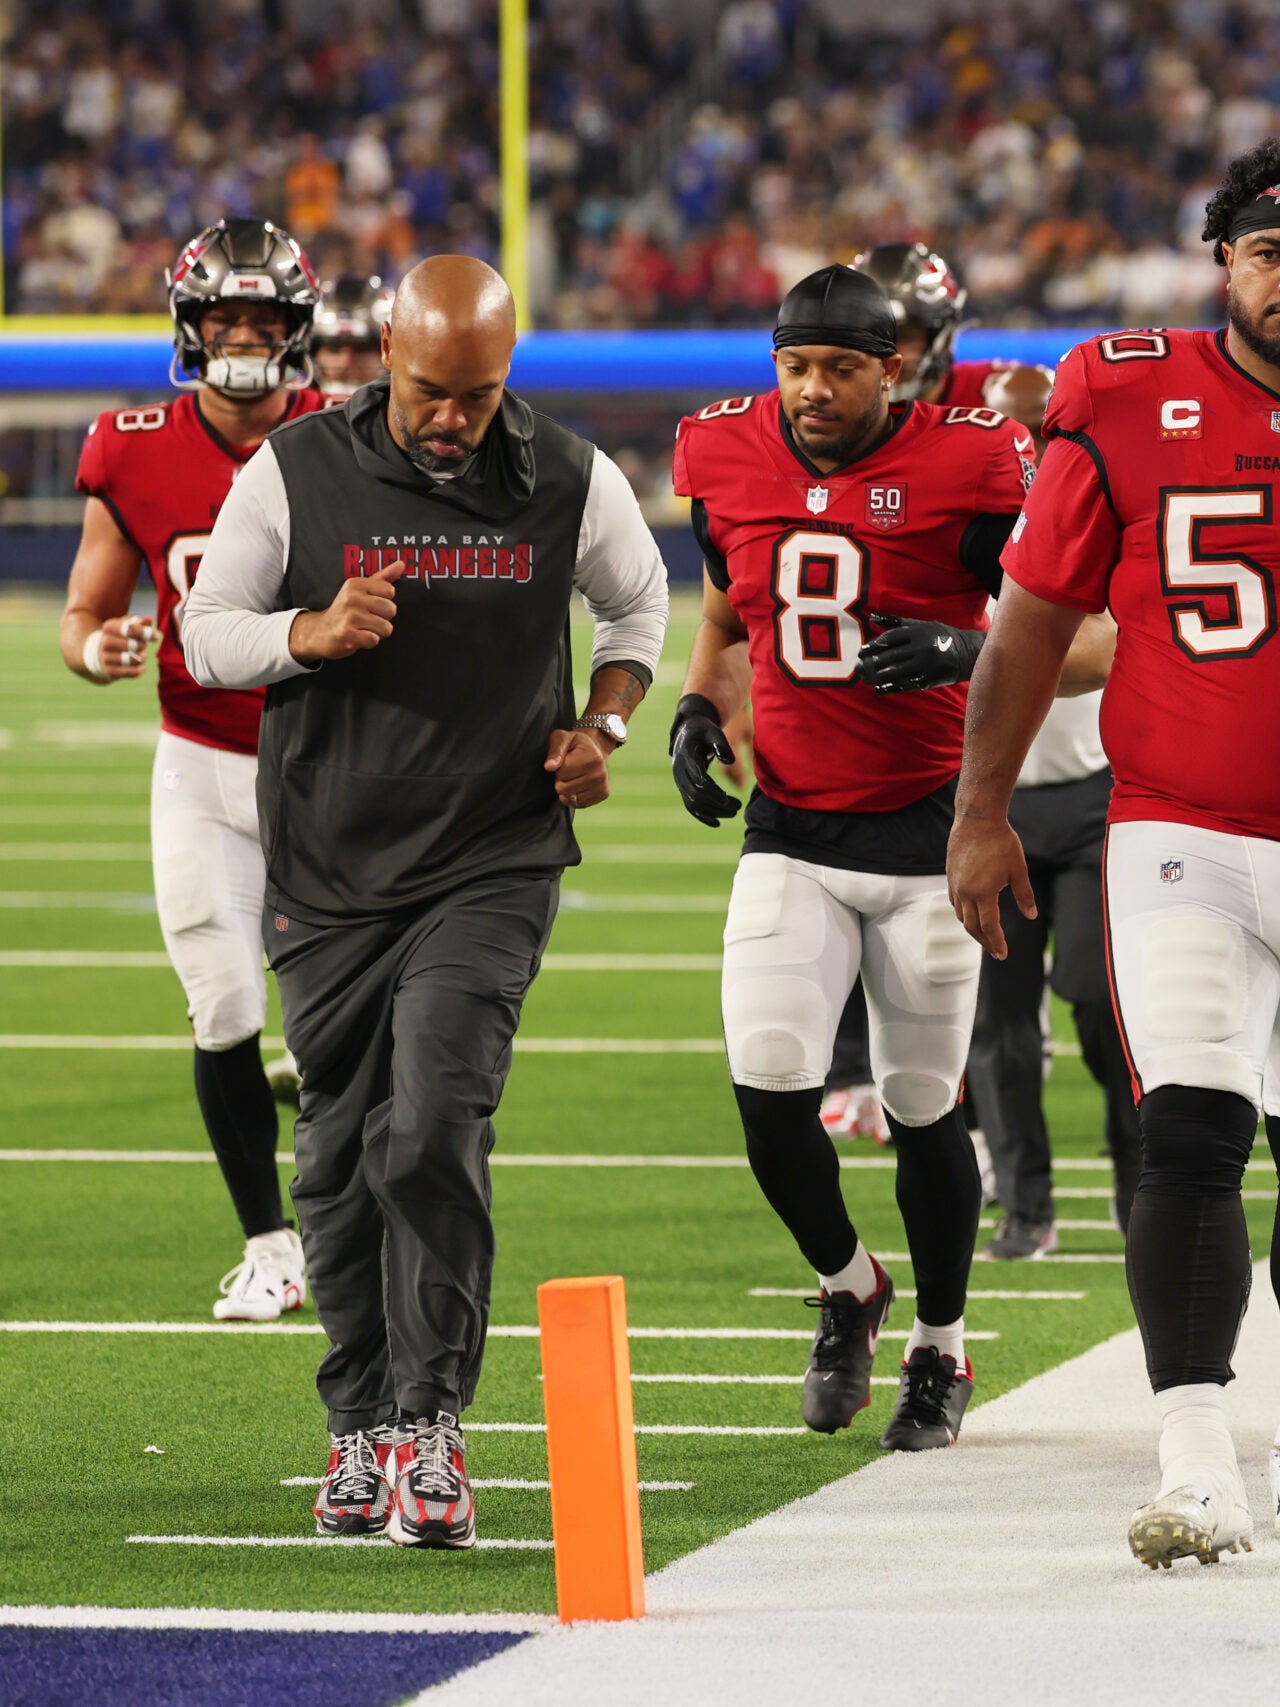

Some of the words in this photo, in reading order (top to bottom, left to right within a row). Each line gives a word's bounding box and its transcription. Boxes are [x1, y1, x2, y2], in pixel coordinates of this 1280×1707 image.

[1160, 399, 1201, 430] C
[869, 488, 902, 510] 50
[371, 536, 449, 546] TAMPA
[462, 536, 505, 546] BAY
[771, 530, 871, 688] 8
